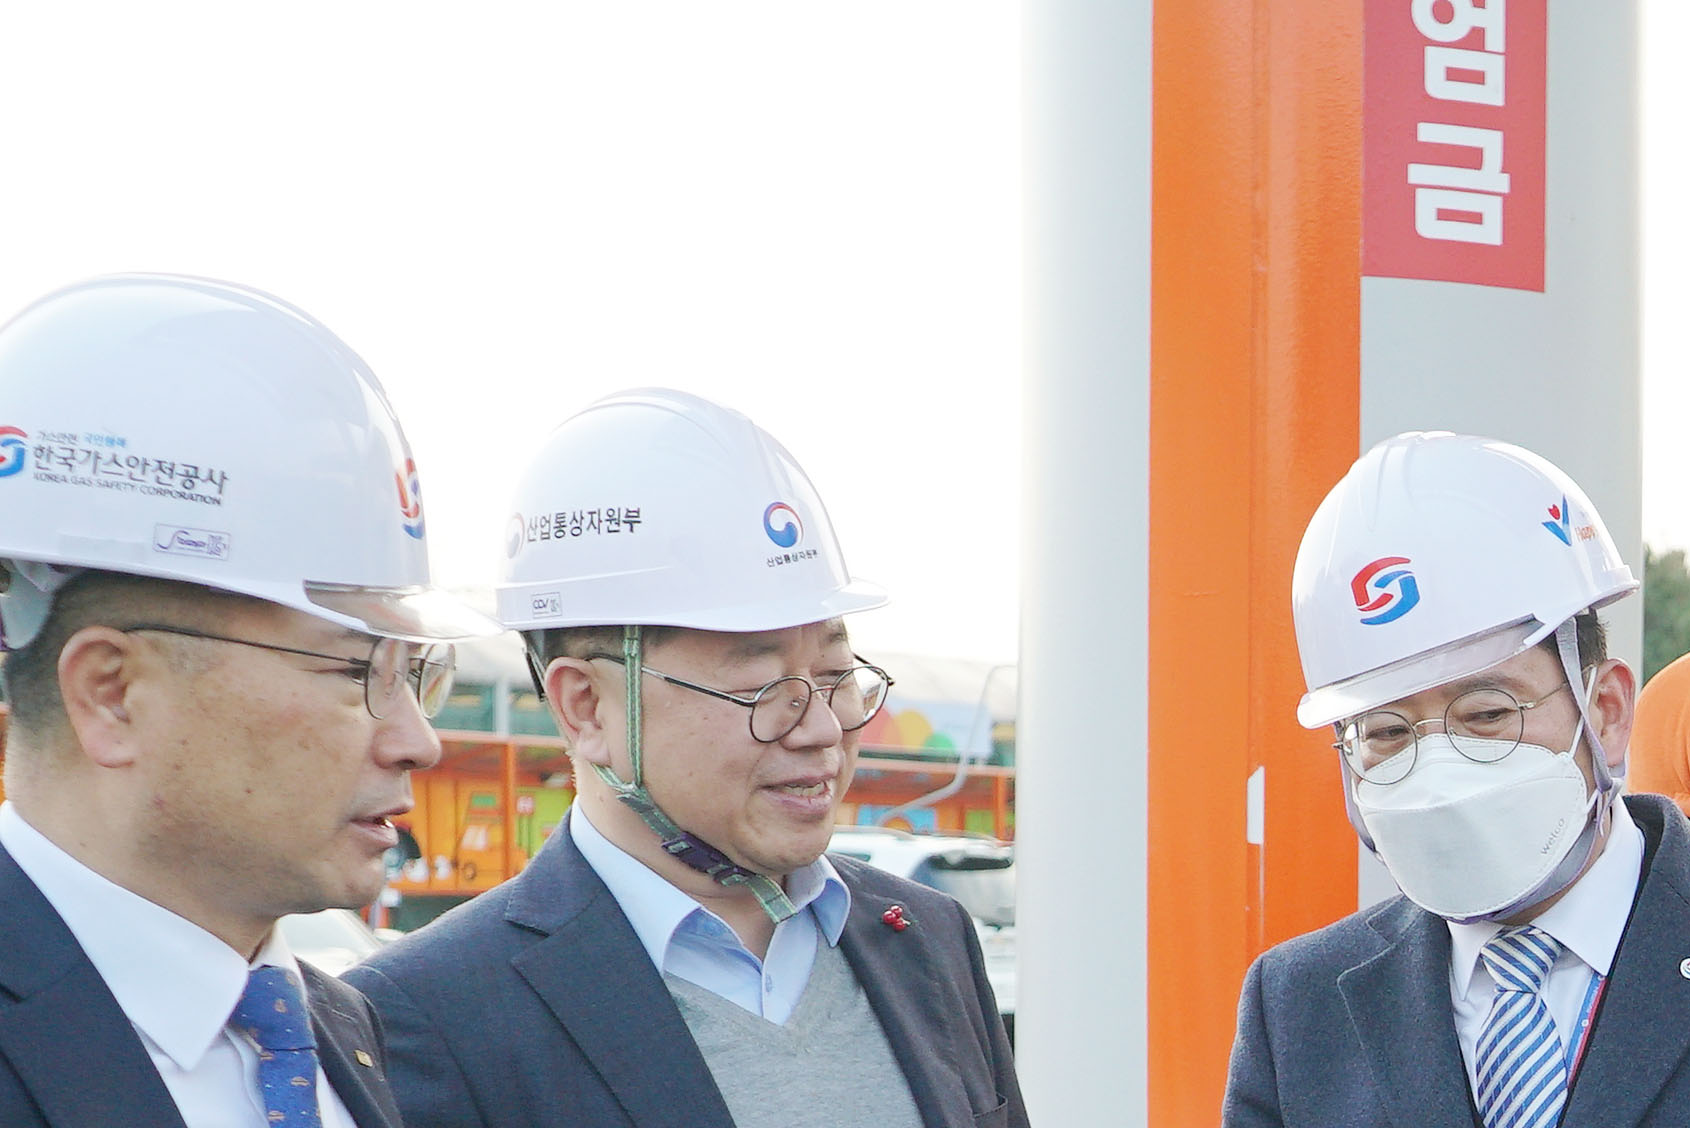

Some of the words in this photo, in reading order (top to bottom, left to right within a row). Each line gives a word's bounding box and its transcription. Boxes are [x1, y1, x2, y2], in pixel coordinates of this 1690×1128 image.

[33, 445, 229, 494] 한국가스안전공사
[33, 472, 68, 484] KOREA
[71, 477, 93, 487] GAS
[96, 479, 136, 492] SAFETY
[140, 485, 222, 506] CORPORATION
[527, 507, 642, 543] 산업통상자원부
